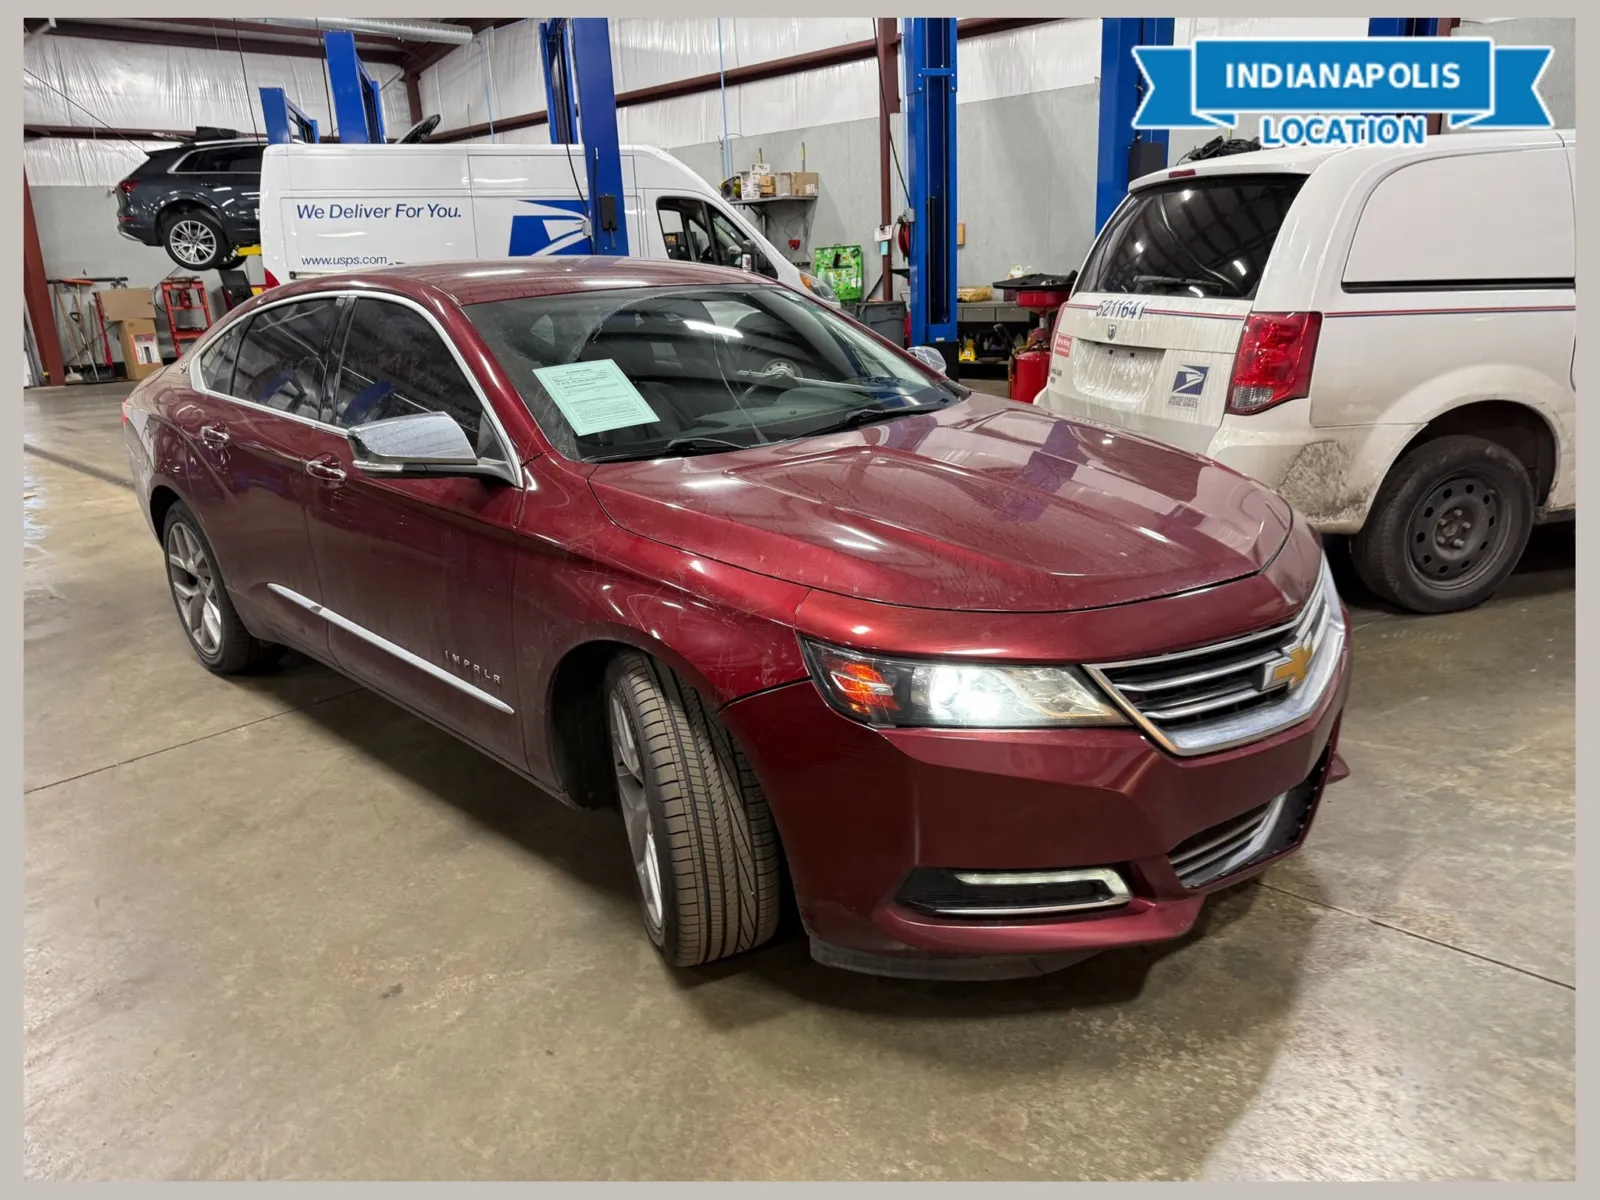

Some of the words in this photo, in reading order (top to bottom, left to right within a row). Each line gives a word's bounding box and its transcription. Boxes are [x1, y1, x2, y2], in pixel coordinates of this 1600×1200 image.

[296, 203, 325, 219] We
[329, 203, 391, 219] Deliver
[395, 203, 424, 218] For
[427, 203, 462, 218] You.
[301, 255, 388, 267] www.usps.com
[1096, 300, 1148, 320] 5211641
[445, 650, 501, 684] IMPALA
